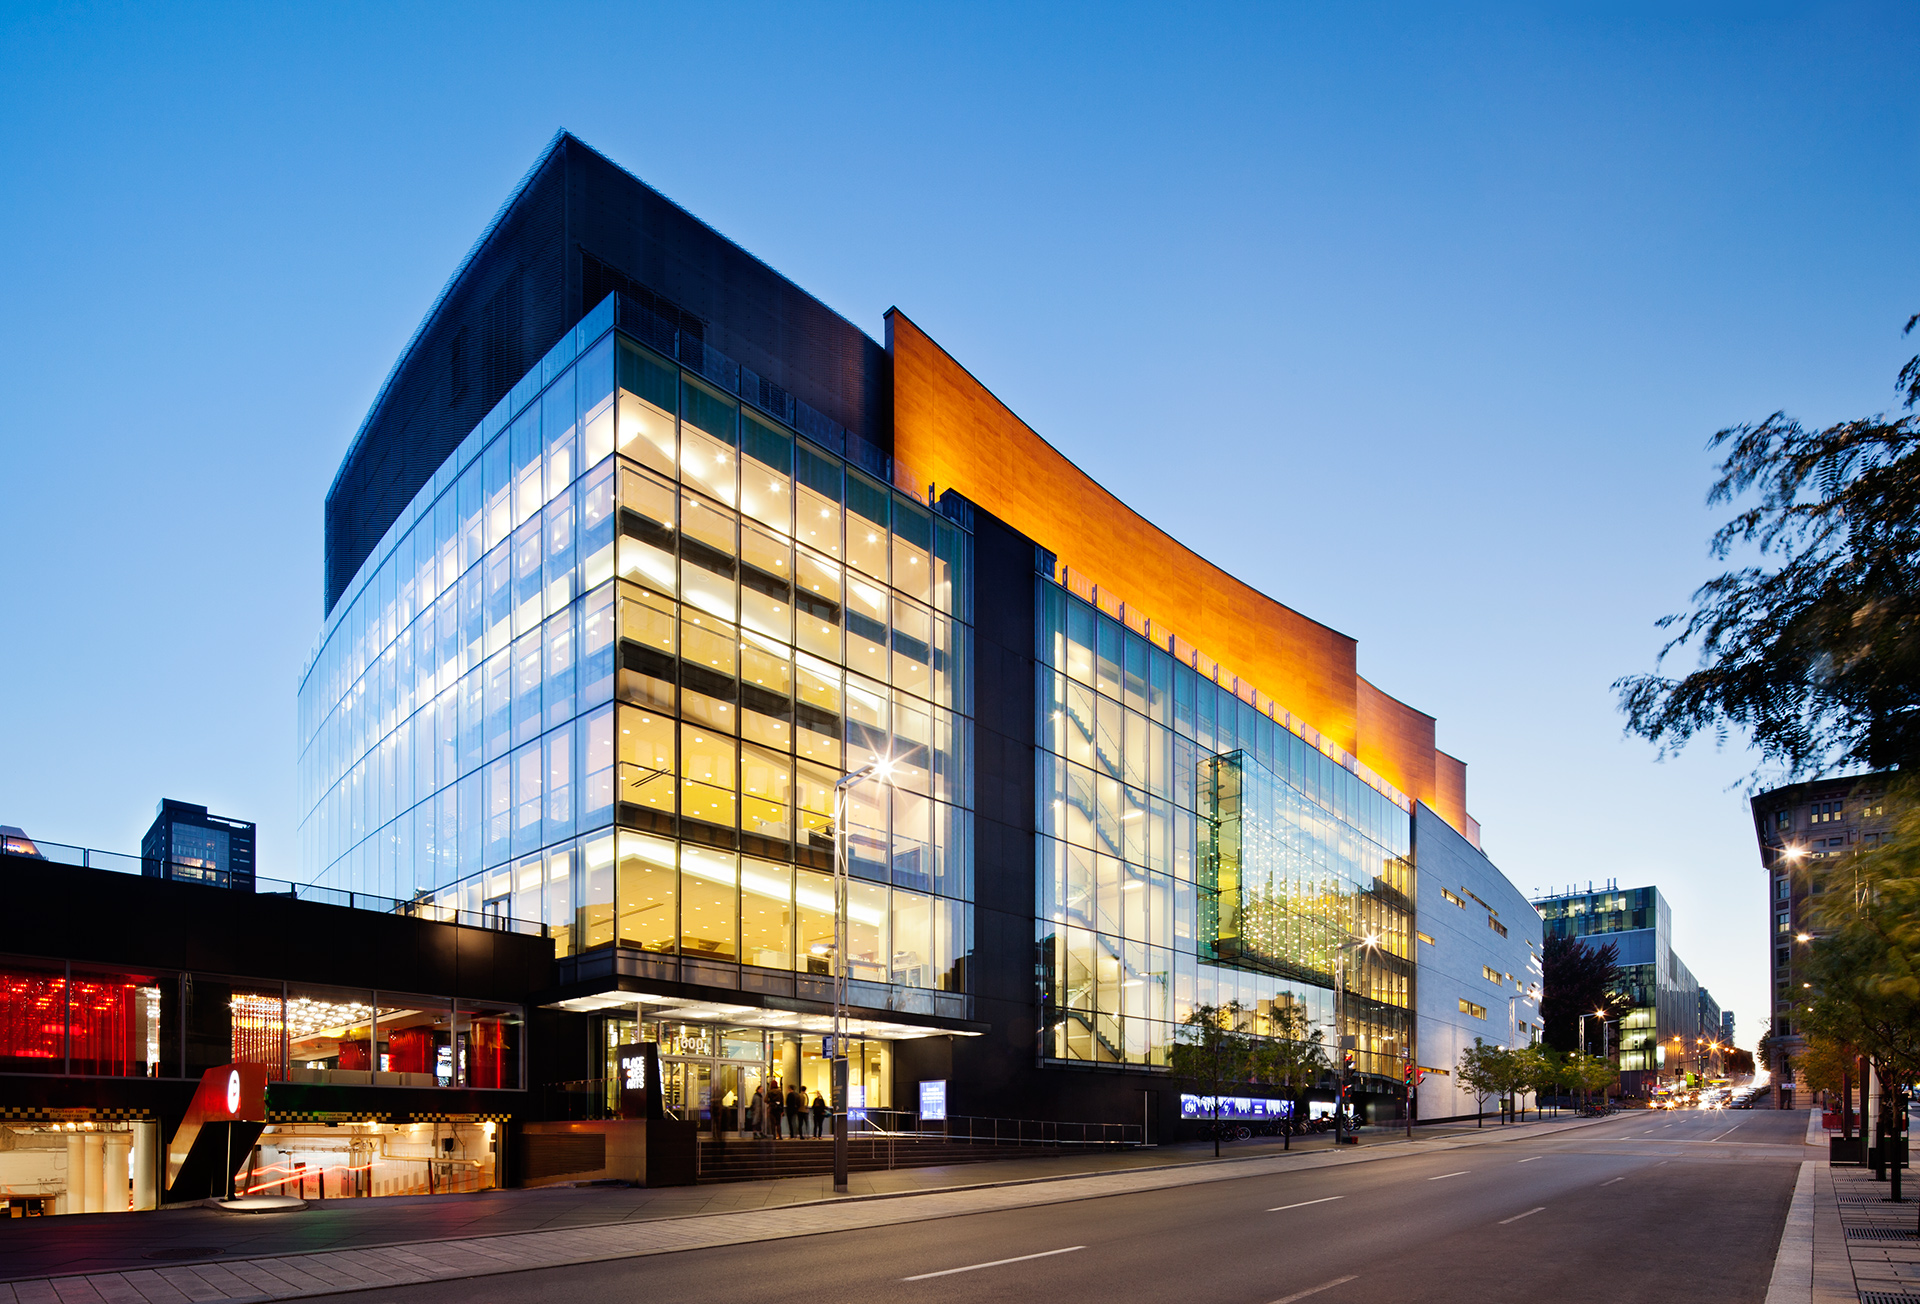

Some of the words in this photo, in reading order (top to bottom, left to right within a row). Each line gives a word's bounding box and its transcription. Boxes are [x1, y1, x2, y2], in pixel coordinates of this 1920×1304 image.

[673, 1036, 704, 1050] 1600
[622, 1056, 645, 1069] PLACE
[626, 1079, 645, 1089] ARTS
